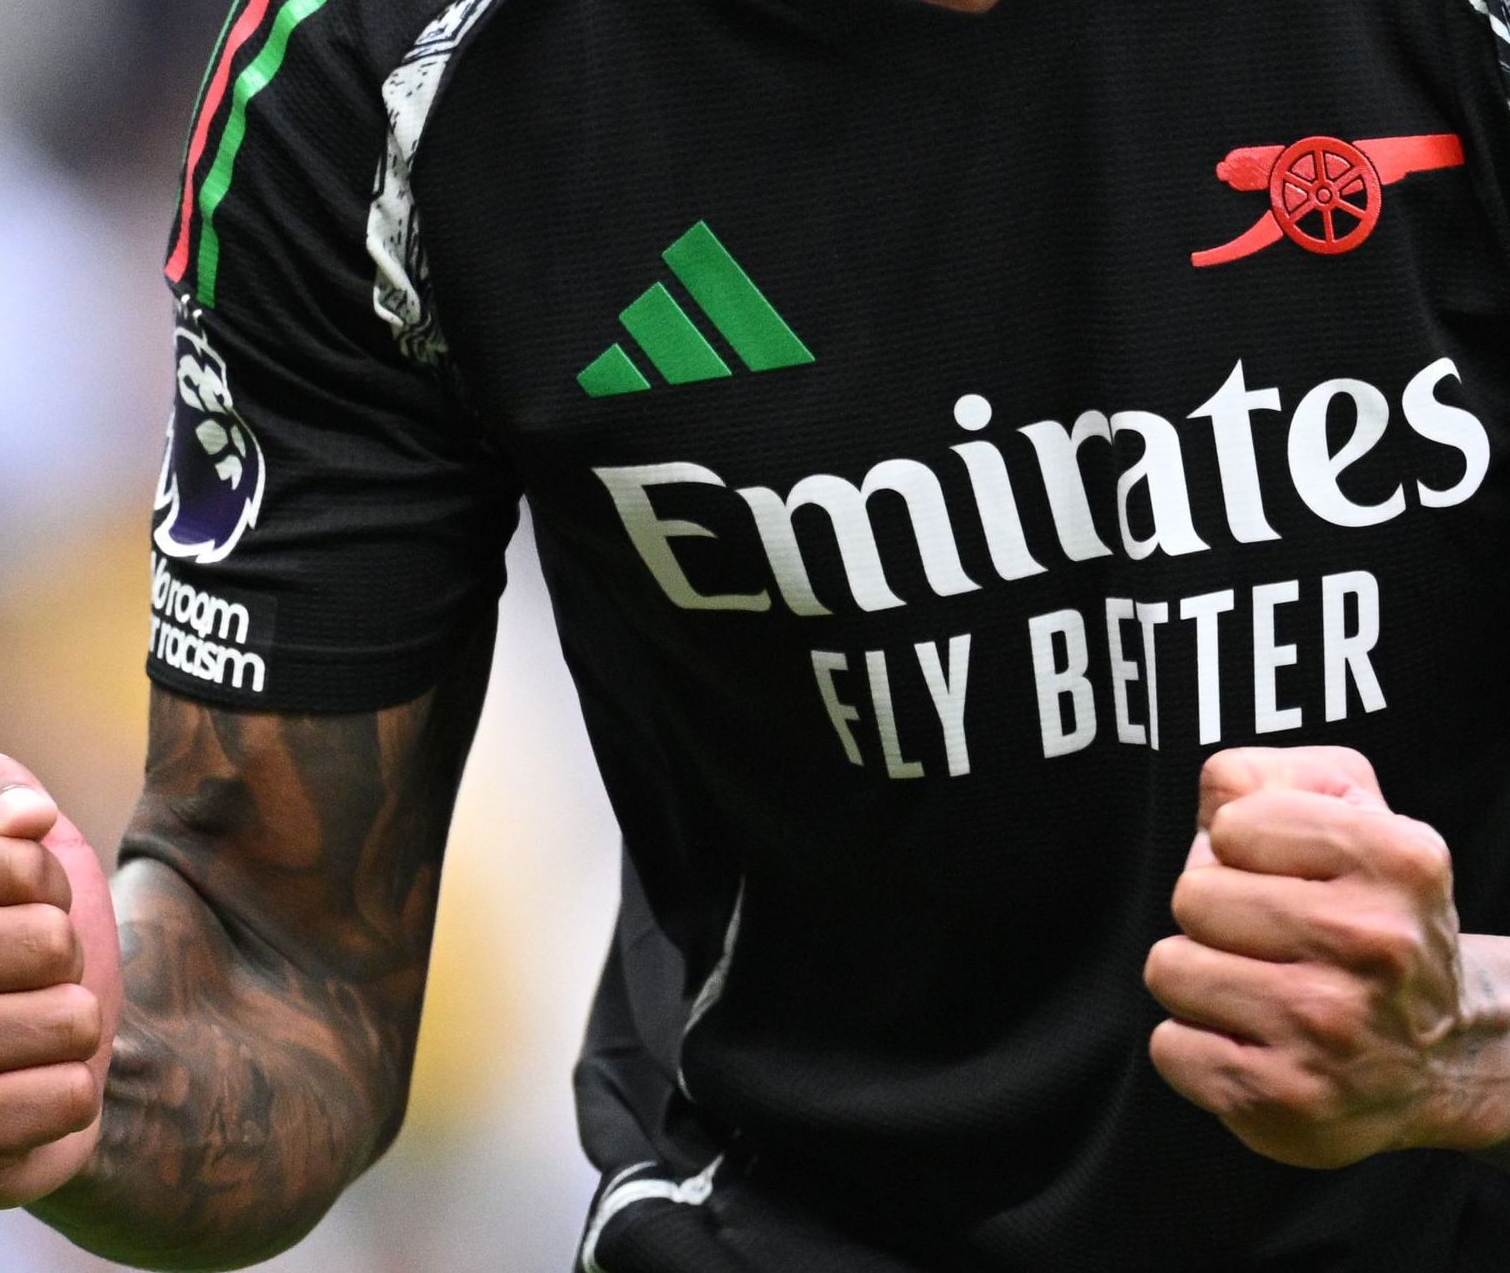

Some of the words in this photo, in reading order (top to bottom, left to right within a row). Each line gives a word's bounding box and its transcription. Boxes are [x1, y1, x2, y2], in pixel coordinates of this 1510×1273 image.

[592, 357, 1491, 615] Emirates
[157, 622, 266, 692] racism
[165, 579, 250, 644] room
[811, 633, 972, 779] FLY
[1028, 570, 1387, 759] BETTER
